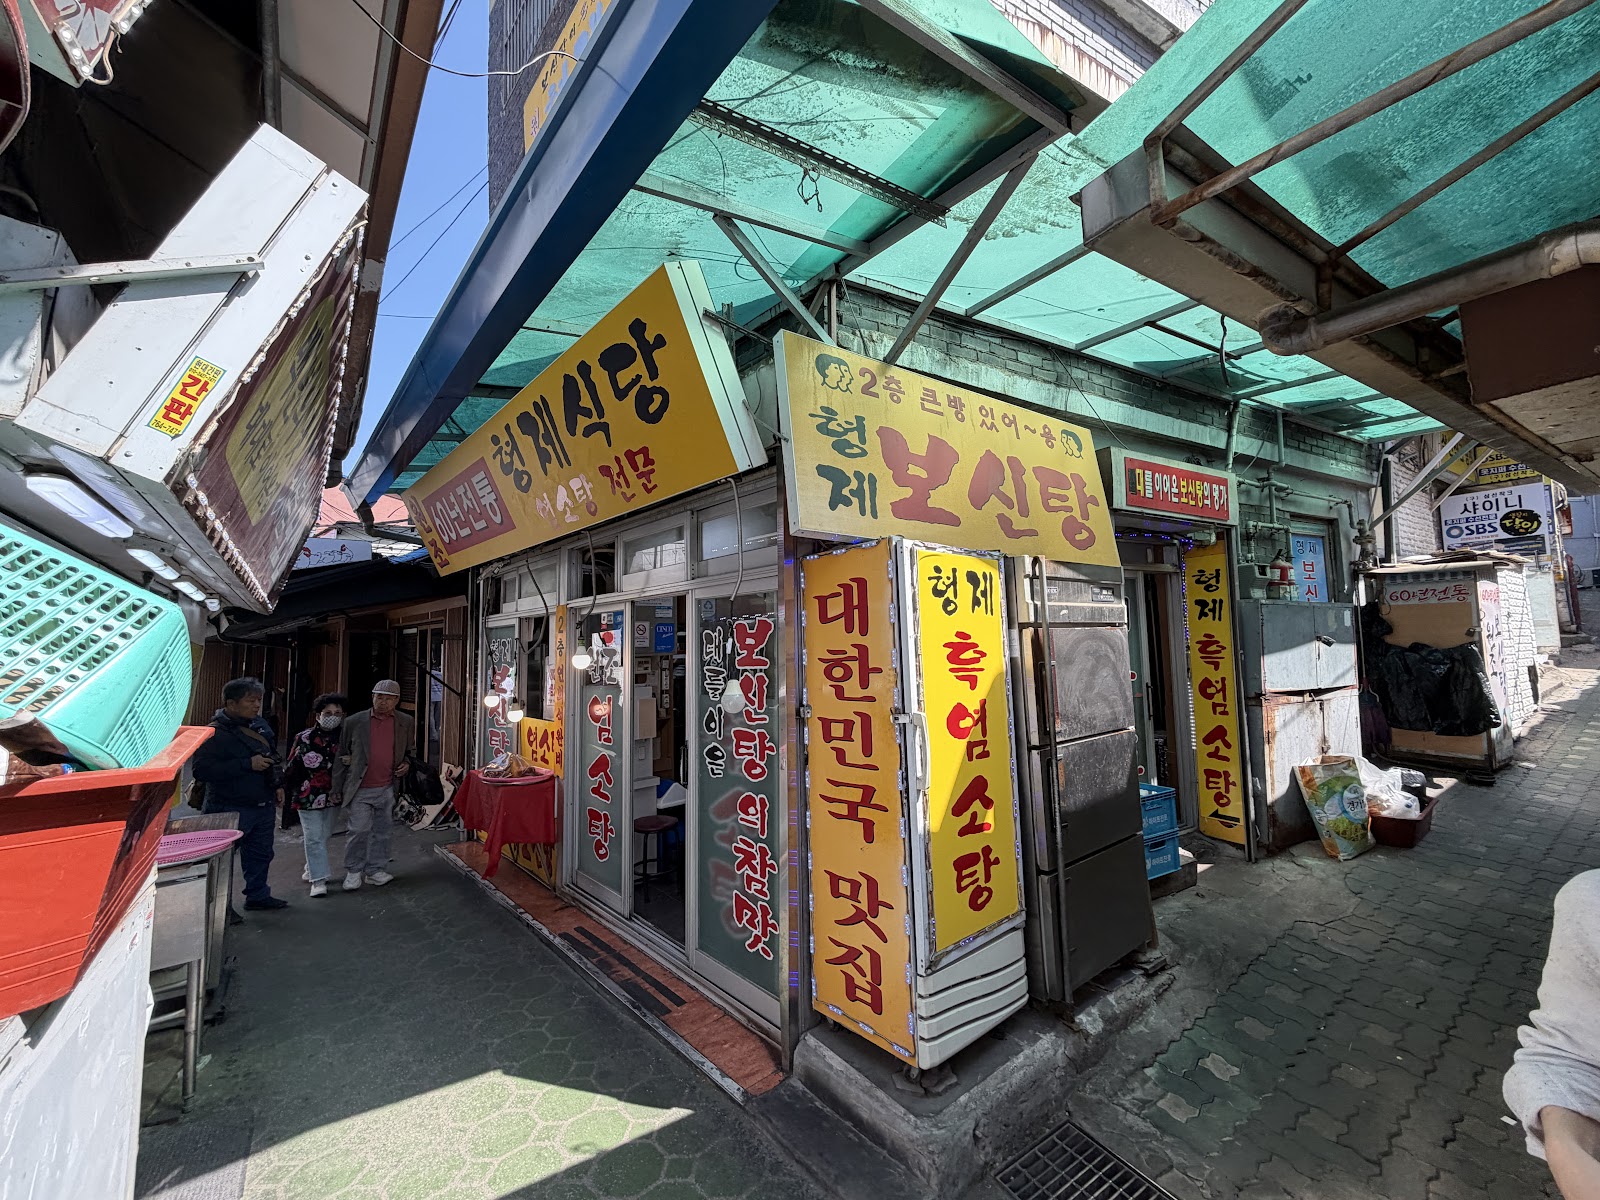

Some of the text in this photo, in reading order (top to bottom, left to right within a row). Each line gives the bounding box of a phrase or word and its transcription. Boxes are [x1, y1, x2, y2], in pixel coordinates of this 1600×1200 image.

[162, 374, 209, 426] 간판
[491, 317, 670, 494] 형제식당
[858, 366, 906, 405] 2층
[920, 386, 966, 423] 큰방
[598, 446, 657, 503] 전문
[808, 405, 879, 520] 형제
[875, 425, 1100, 550] 보신탕
[408, 495, 450, 569] 원조
[431, 470, 503, 545] 60년전통
[1460, 494, 1523, 515] 샤이니
[1464, 521, 1499, 537] SBS
[1295, 540, 1317, 555] 형제
[928, 564, 994, 617] 형제
[1389, 583, 1471, 602] 60년전통
[556, 615, 565, 657] 2층
[1191, 568, 1237, 808] 형제 흑염소탕
[526, 724, 555, 766] 염소
[942, 630, 1001, 912] 흑염소탕
[587, 694, 616, 864] 염소탕
[813, 576, 895, 1016] 대한민국 맛집
[731, 835, 779, 960] 참맛
